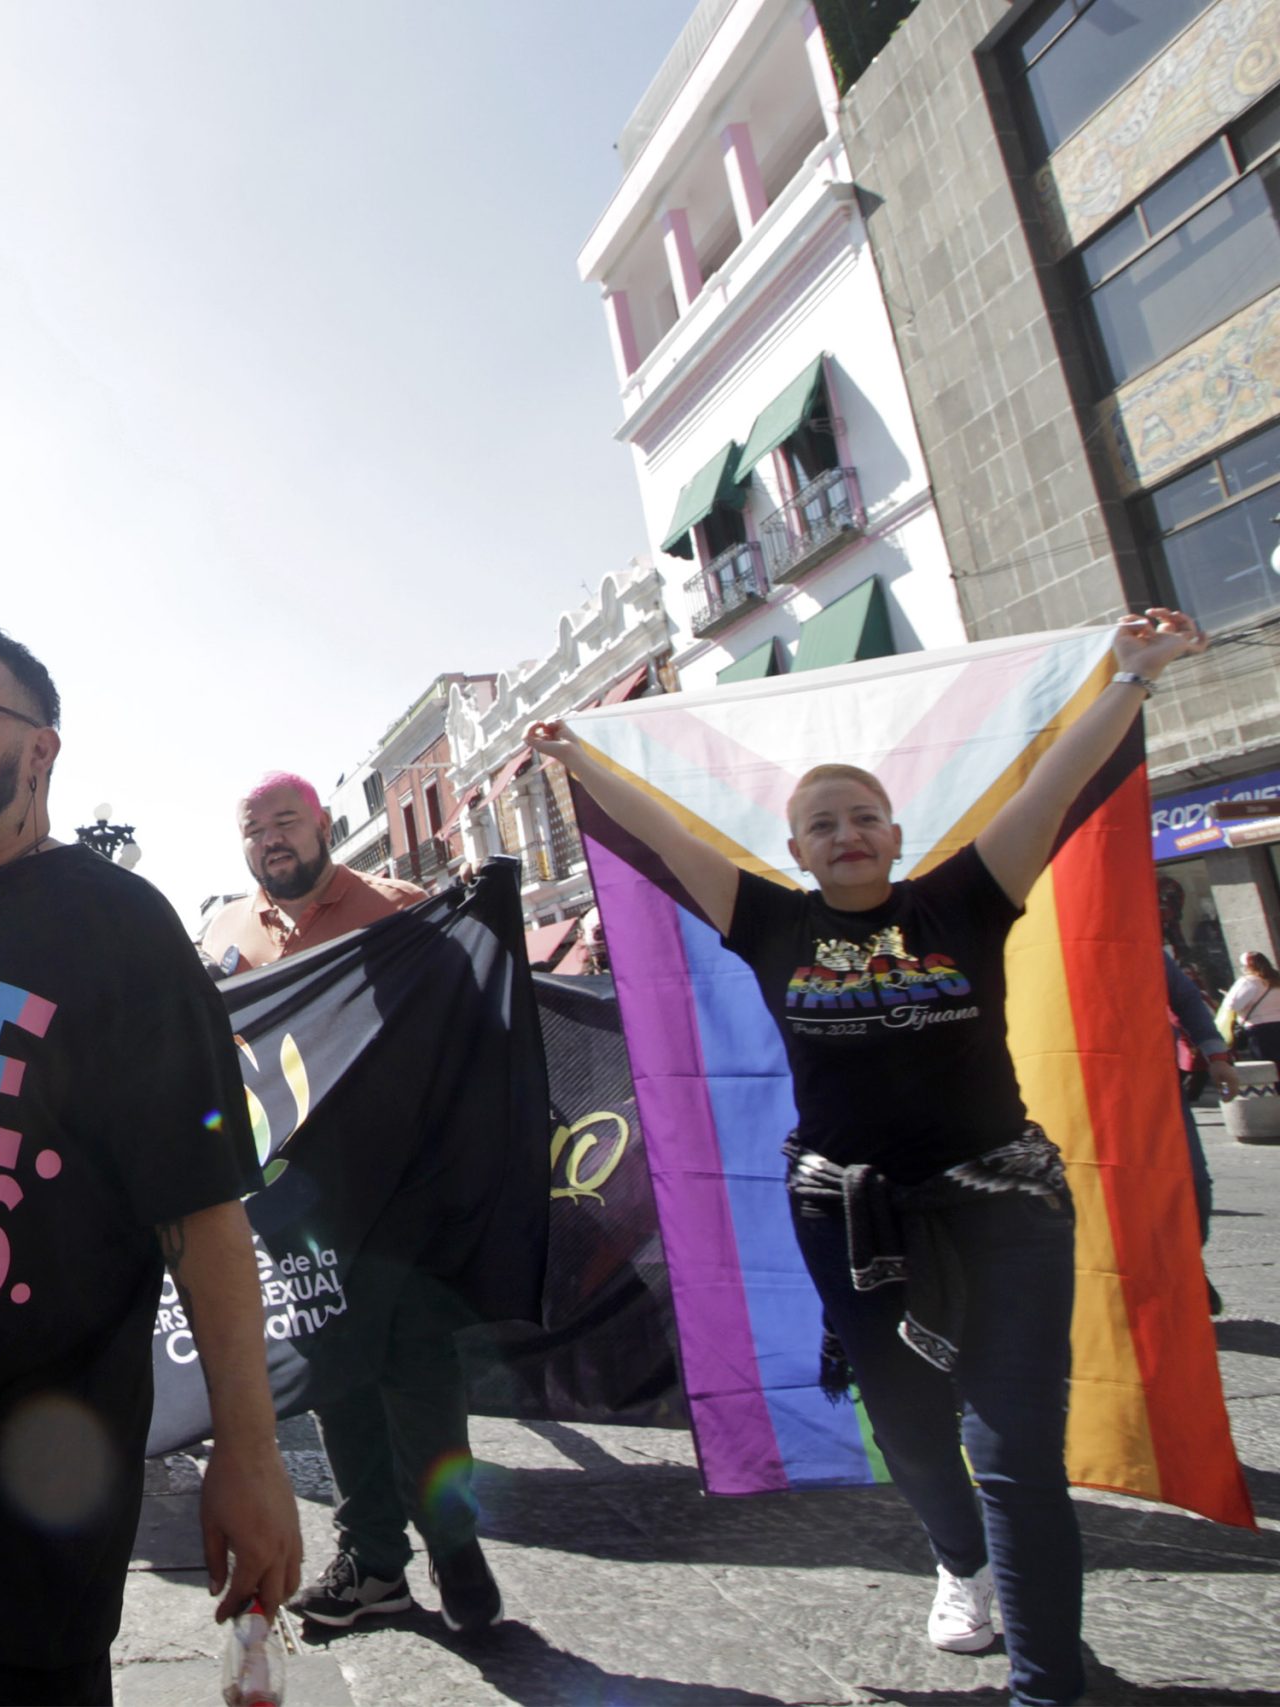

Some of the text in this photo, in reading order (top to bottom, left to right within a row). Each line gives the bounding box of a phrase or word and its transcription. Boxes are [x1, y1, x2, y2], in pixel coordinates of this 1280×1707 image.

[826, 1022, 868, 1036] 2022
[881, 1004, 980, 1031] Tijuana
[279, 1252, 311, 1275] de
[313, 1247, 338, 1269] la
